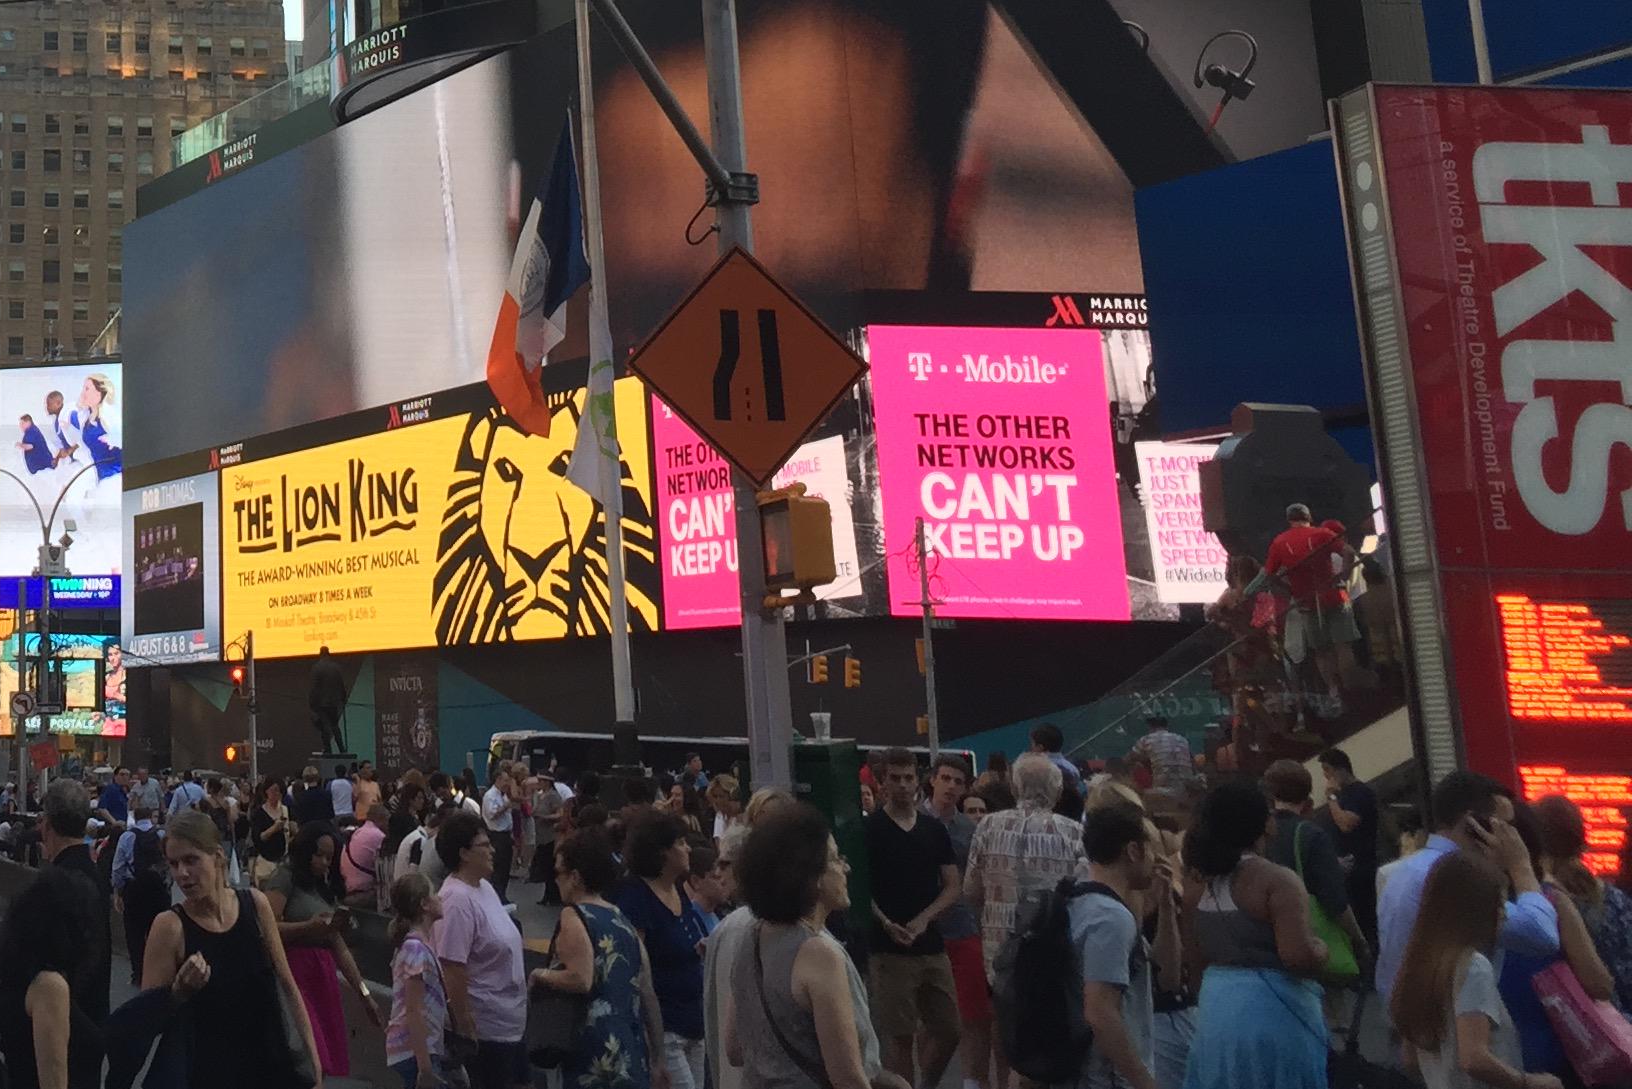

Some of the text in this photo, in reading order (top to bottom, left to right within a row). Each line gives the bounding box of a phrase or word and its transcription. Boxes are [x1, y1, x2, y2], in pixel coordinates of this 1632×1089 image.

[350, 25, 408, 58] MARRIOTT
[351, 46, 400, 75] MARQUIS
[223, 133, 257, 157] MARRIOTT
[223, 149, 254, 170] MARQUIS
[1439, 140, 1511, 531] a service of Theatre Development Fund
[914, 413, 1071, 439] THE OTHER
[665, 444, 693, 468] THE
[916, 444, 1076, 470] NETWORKS
[142, 480, 196, 511] ROB THOMAS
[920, 471, 1078, 521] CAN'T
[1150, 475, 1190, 491] JUST
[233, 457, 419, 553] THE LION KING
[924, 523, 1085, 562] KEEP UP
[238, 548, 420, 587] THE AWARD-WINNING BEST MUSICAL
[671, 541, 723, 577] KEEP
[51, 577, 113, 592] TWINNING
[268, 586, 373, 609] ON BROADWAY 8 TIMES A WEEK
[129, 637, 162, 656] AUGUST
[163, 635, 170, 654] 6
[171, 635, 178, 654] &
[179, 634, 186, 653] 8
[390, 676, 424, 692] INVICTA
